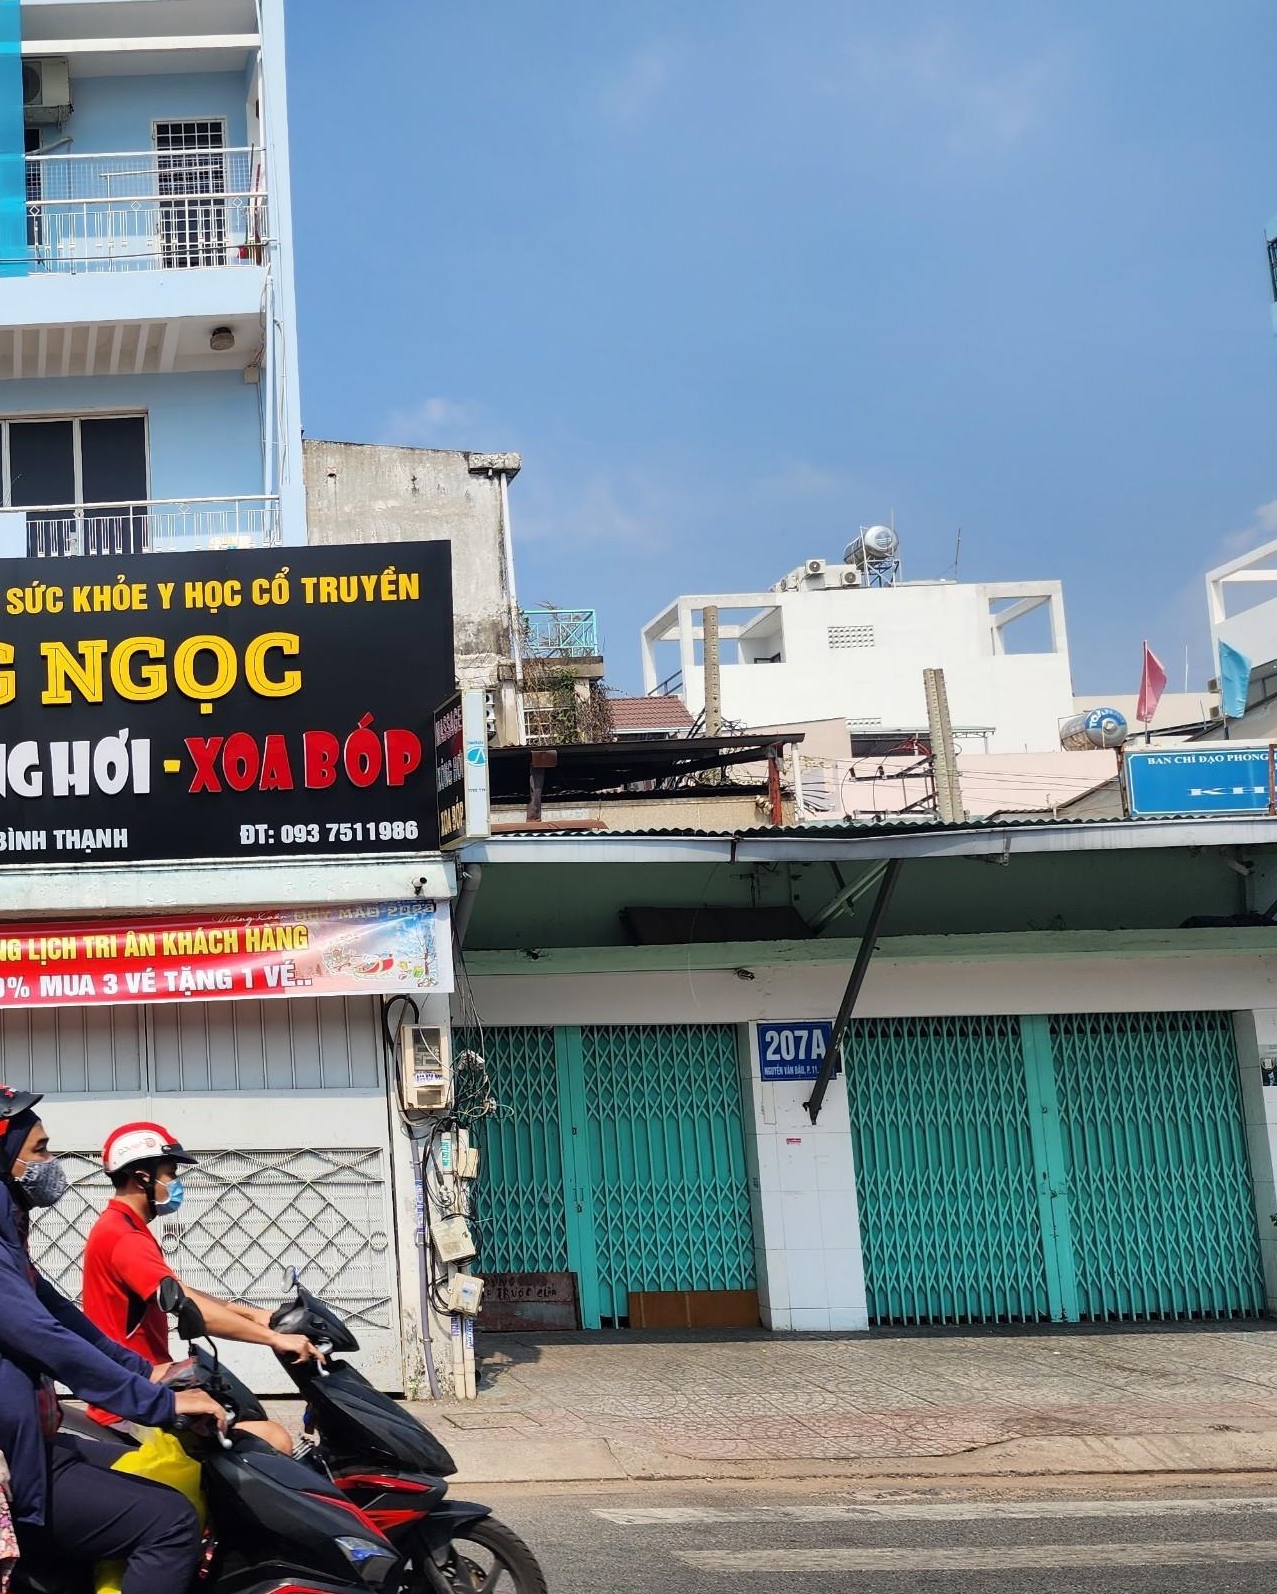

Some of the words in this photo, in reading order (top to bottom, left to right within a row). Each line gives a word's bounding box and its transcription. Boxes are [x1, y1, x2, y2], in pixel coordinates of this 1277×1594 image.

[6, 579, 64, 616] SỨC
[73, 574, 148, 613] KHỎE
[156, 582, 175, 609] Y
[184, 579, 242, 614] HỌC
[251, 566, 291, 606] CỔ
[300, 565, 421, 604] TRUYỀN
[40, 631, 302, 715] NGỌC
[48, 727, 151, 798] HƠI
[183, 731, 294, 794] XOA
[303, 711, 422, 790] BÓP
[1147, 757, 1172, 765] BAN
[1199, 754, 1225, 765] ĐẠO
[54, 827, 128, 854] THẠNH
[239, 823, 275, 846] ĐT:
[280, 822, 321, 844] 093
[326, 820, 419, 842] 7511986
[28, 934, 77, 966] LỊCH
[82, 934, 117, 959] TRI
[124, 928, 156, 958] ÂN
[163, 924, 239, 956] KHÁCH
[245, 921, 309, 954] HÀNG
[40, 974, 96, 998] MUA
[102, 974, 119, 996] 3
[127, 966, 158, 994] VÉ
[166, 966, 233, 997] TẶNG
[241, 967, 254, 989] 1
[765, 1028, 827, 1061] 207A
